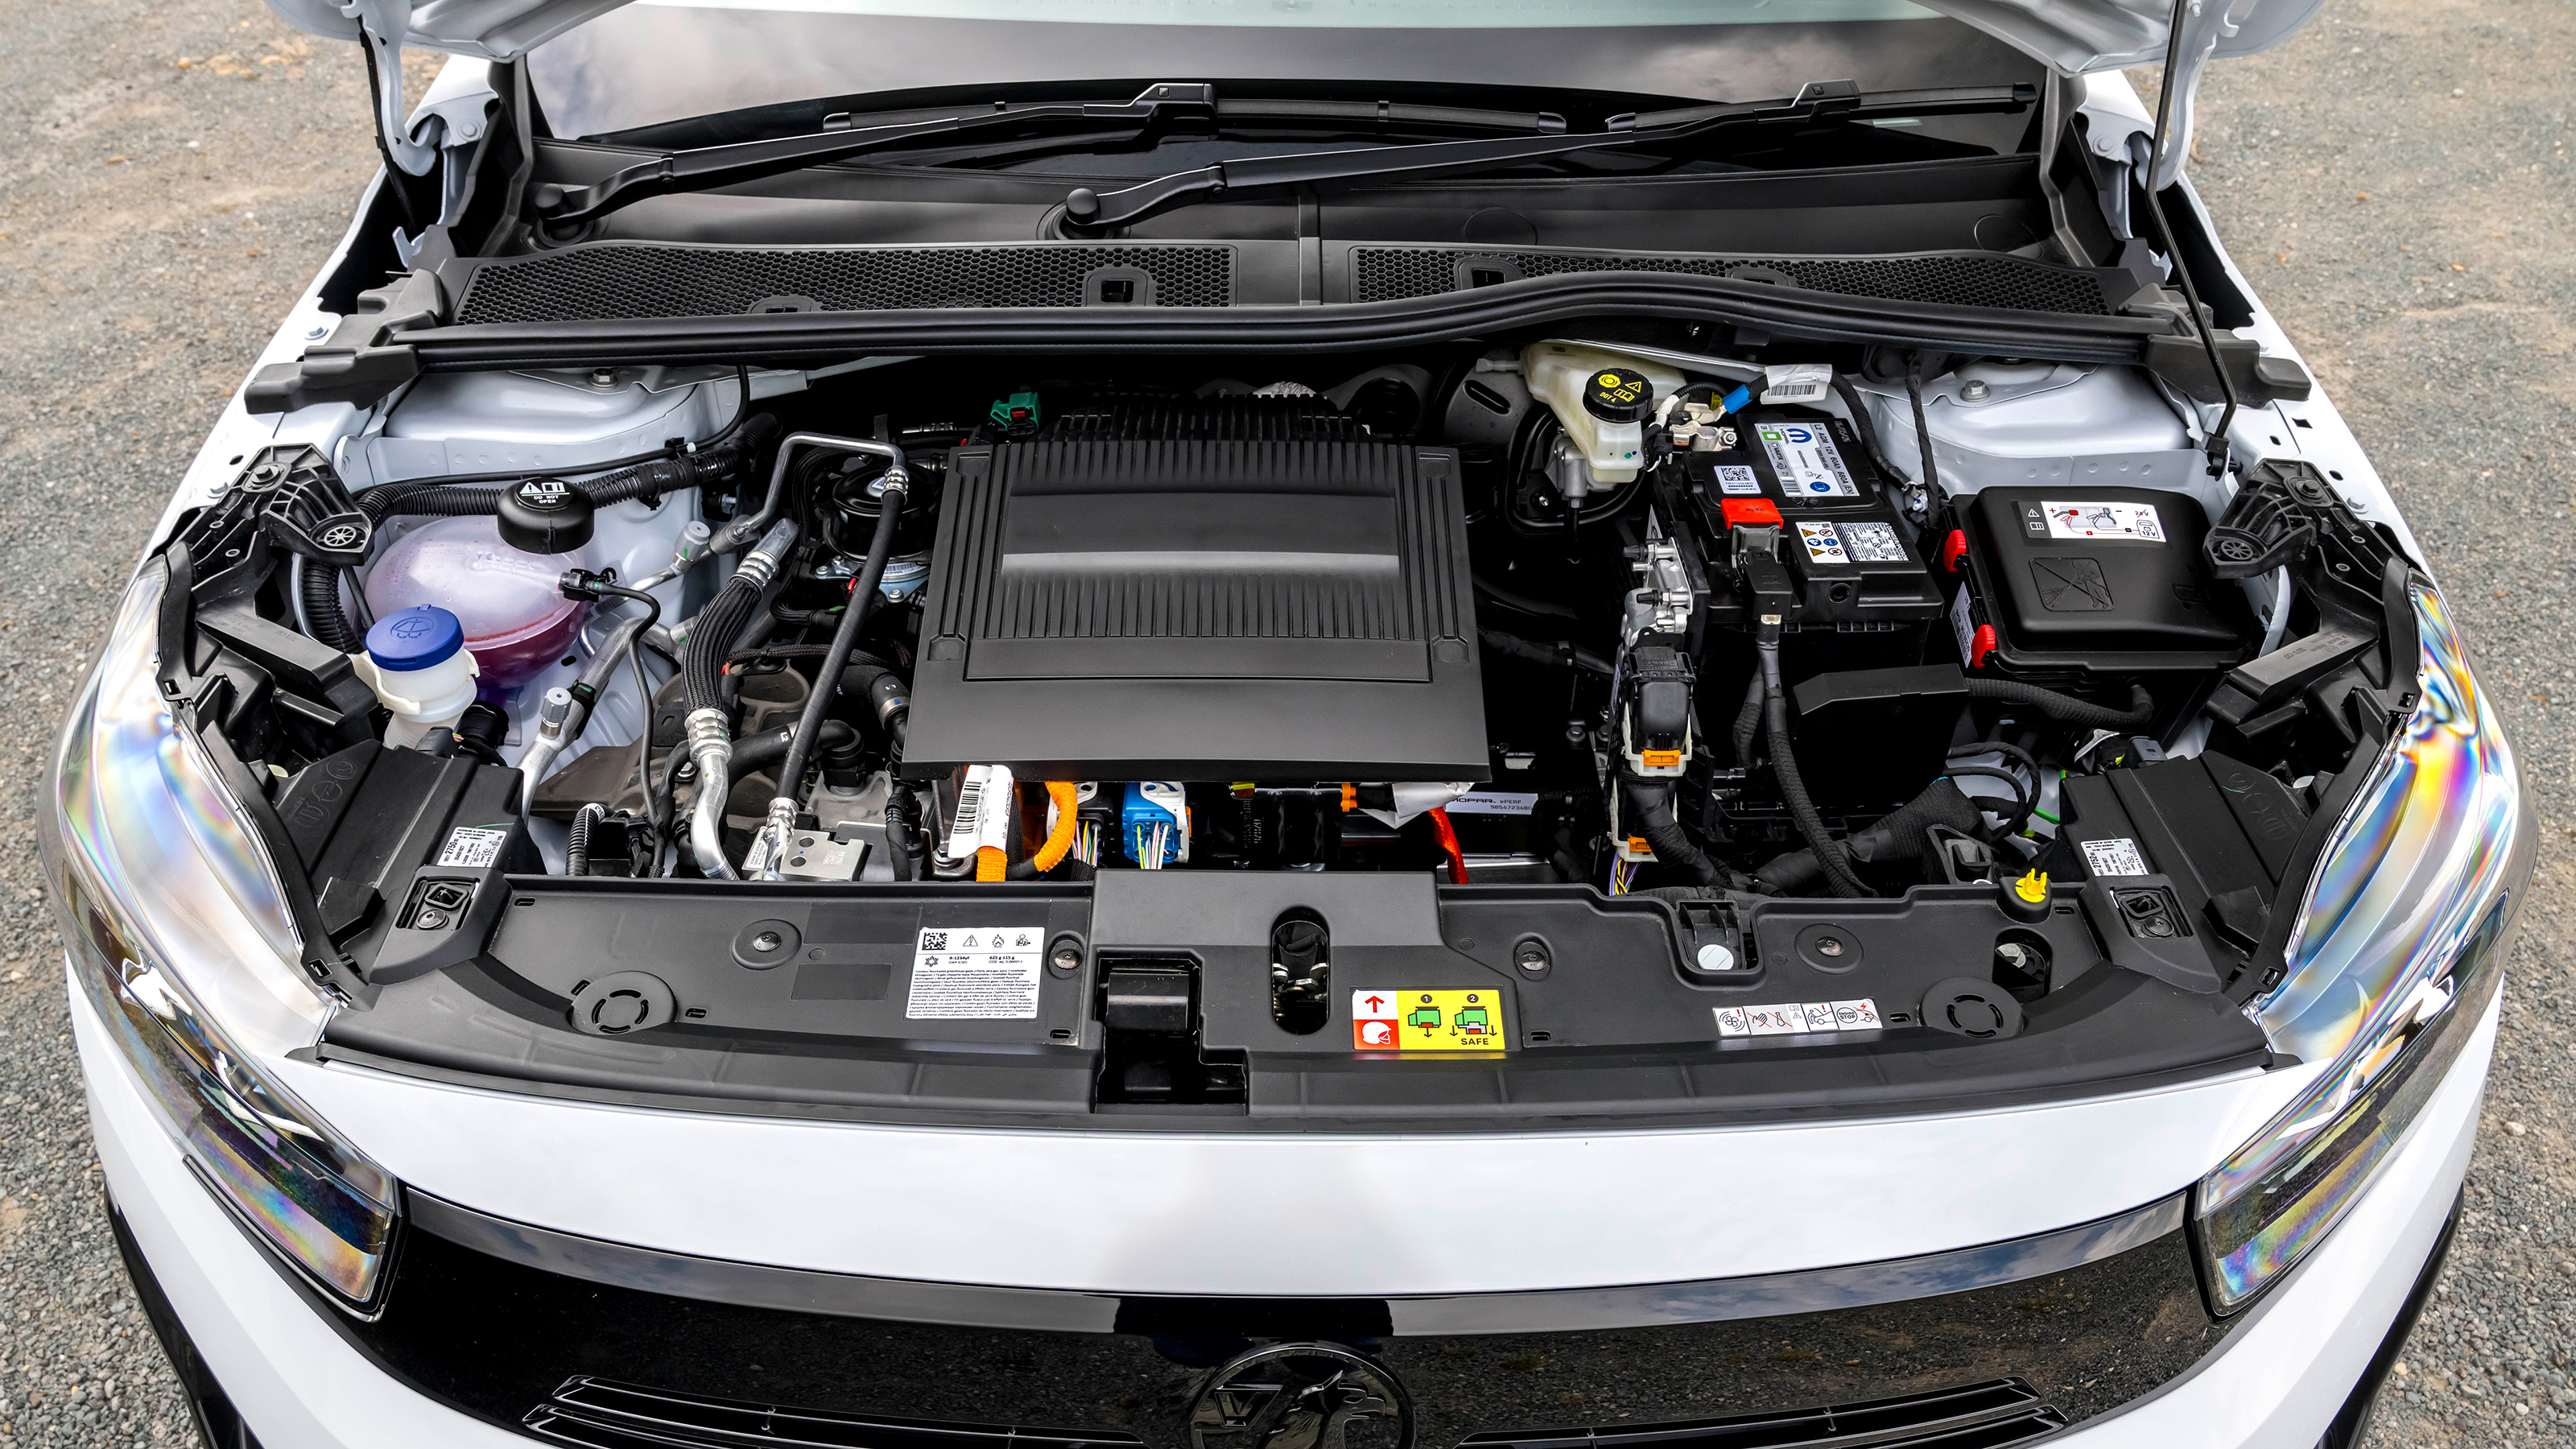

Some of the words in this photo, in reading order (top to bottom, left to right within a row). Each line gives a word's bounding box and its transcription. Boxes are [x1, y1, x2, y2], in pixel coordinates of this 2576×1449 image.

[1600, 391, 1613, 400] DOT
[1818, 432, 1829, 444] AGM
[1825, 446, 1835, 455] 12V
[1830, 456, 1842, 469] 60Ah
[1837, 471, 1849, 484] 680A
